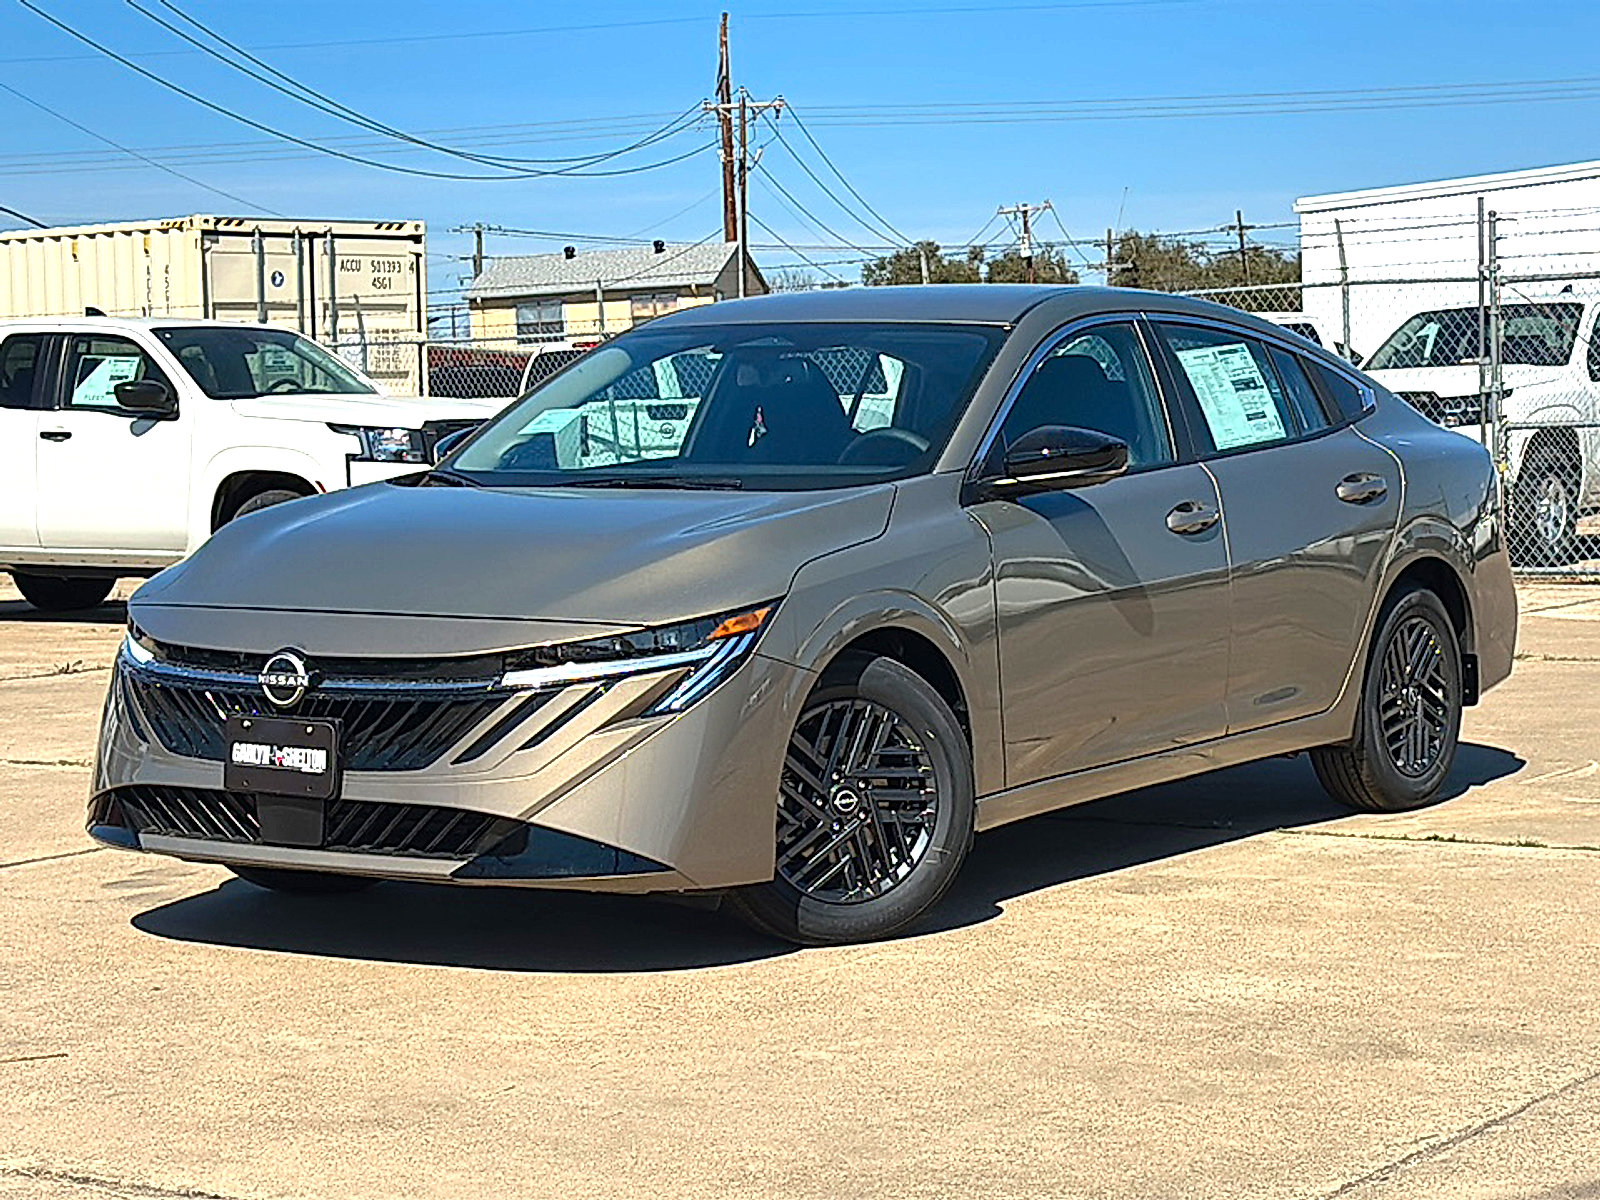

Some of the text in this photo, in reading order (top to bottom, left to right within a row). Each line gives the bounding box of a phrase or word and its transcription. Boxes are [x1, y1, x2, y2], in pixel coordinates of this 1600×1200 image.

[340, 258, 361, 273] ACCU
[371, 276, 391, 290] 45G1
[258, 674, 309, 687] NISSAN
